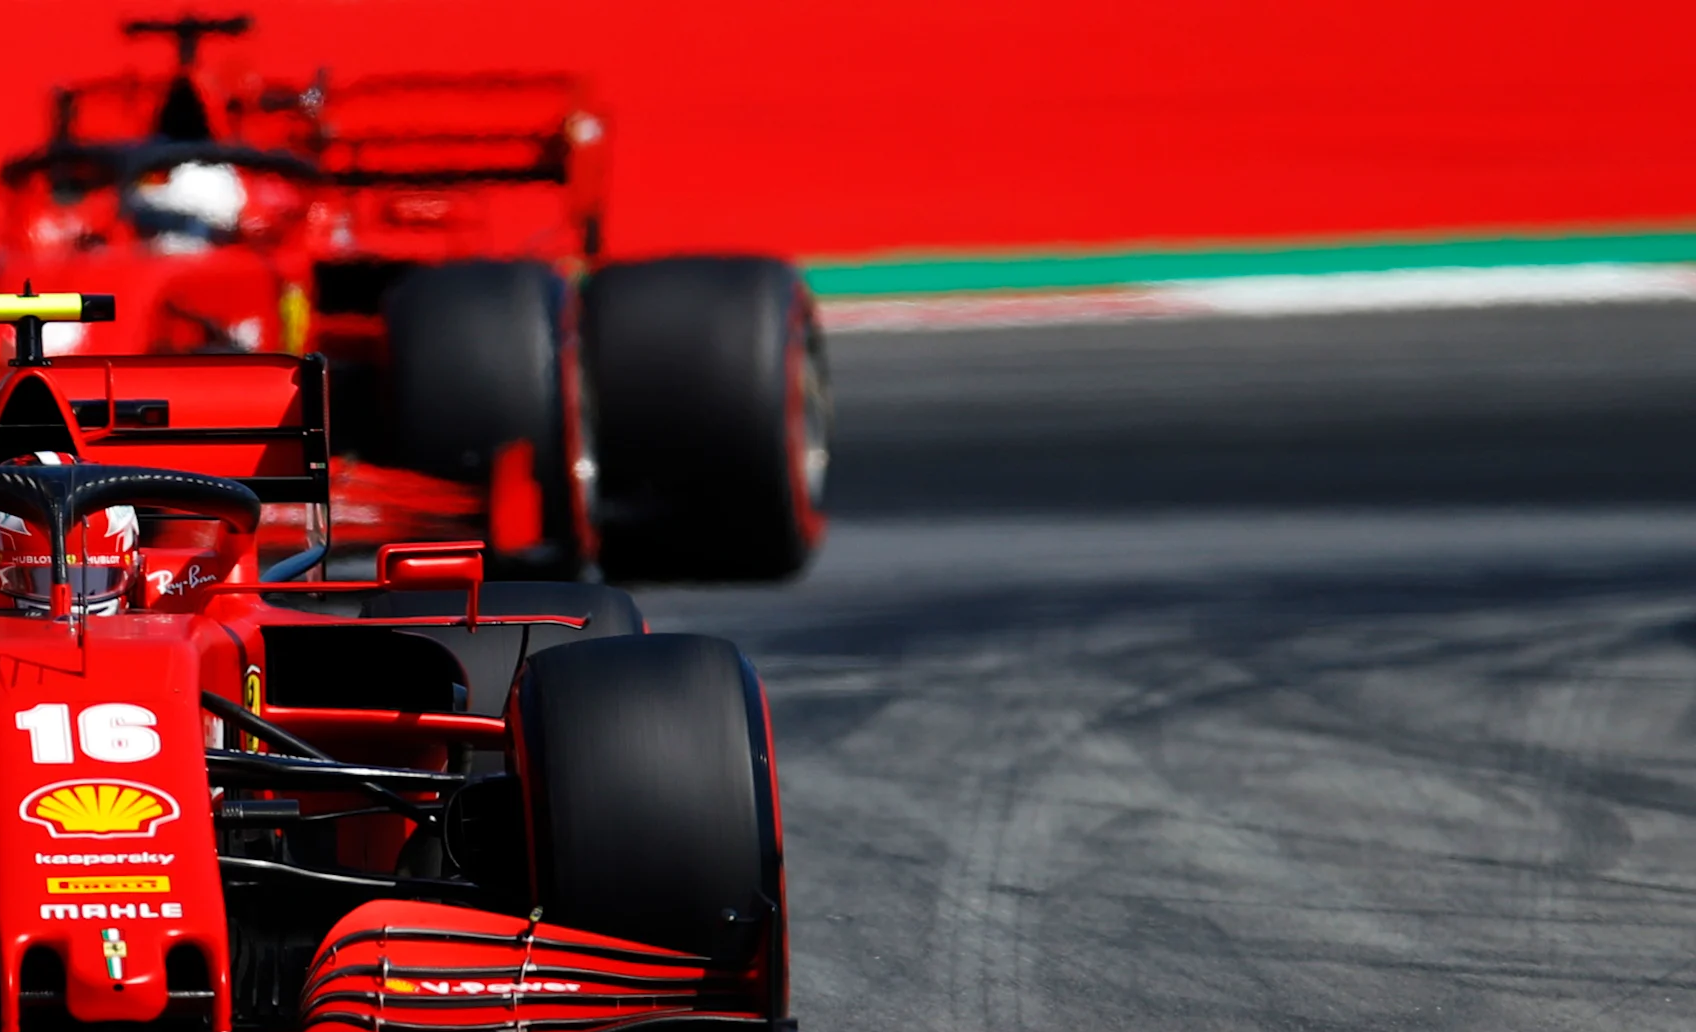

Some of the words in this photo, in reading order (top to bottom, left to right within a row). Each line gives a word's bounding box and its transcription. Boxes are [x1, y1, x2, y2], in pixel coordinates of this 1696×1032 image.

[146, 564, 216, 595] Ray-Ban
[15, 703, 161, 763] 16
[35, 852, 175, 866] kaspersky
[40, 902, 183, 919] MAHLE
